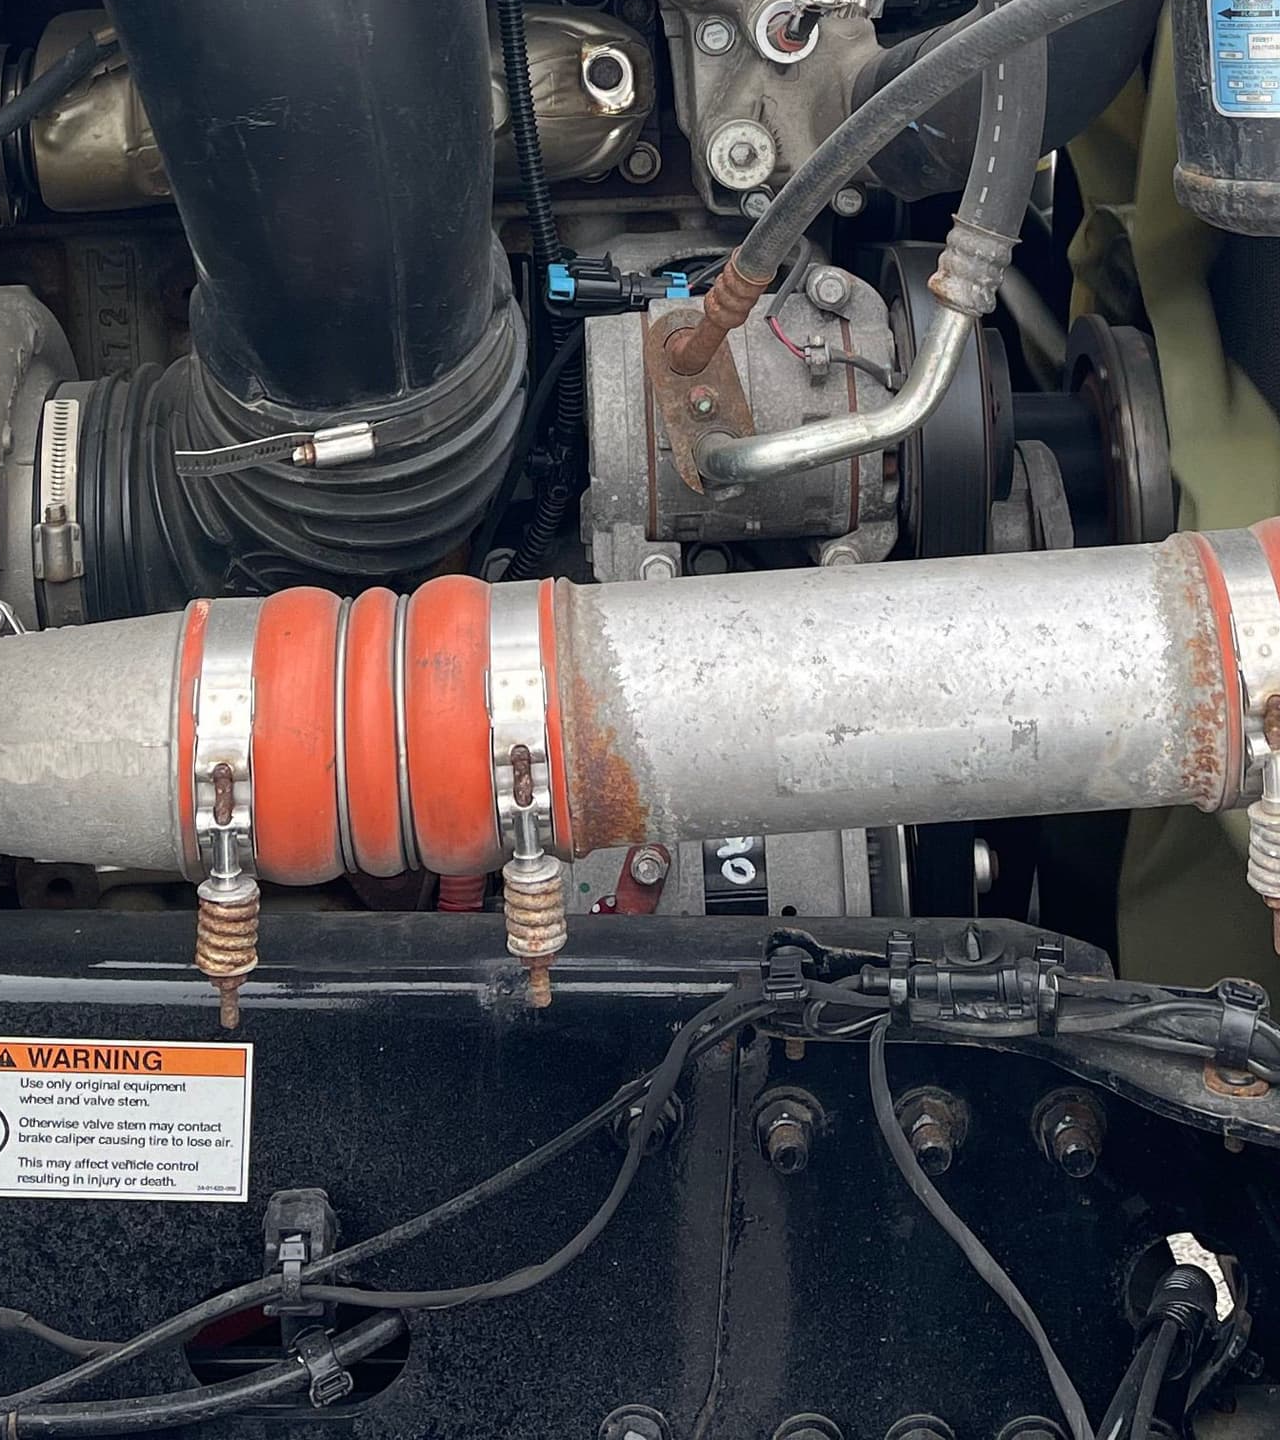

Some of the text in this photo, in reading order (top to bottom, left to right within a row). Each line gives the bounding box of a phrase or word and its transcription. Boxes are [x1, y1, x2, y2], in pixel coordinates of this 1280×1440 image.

[27, 1047, 162, 1071] WARNING
[20, 1077, 186, 1094] Use only original equipment
[19, 1094, 150, 1107] wheel and valve stem.
[18, 1116, 222, 1134] Otherwise valve stem may contact
[18, 1132, 234, 1148] brake caliper causing tire to lose air.
[17, 1156, 199, 1171] This may affect vehicle control
[17, 1173, 176, 1188] resulting in injury or death.
